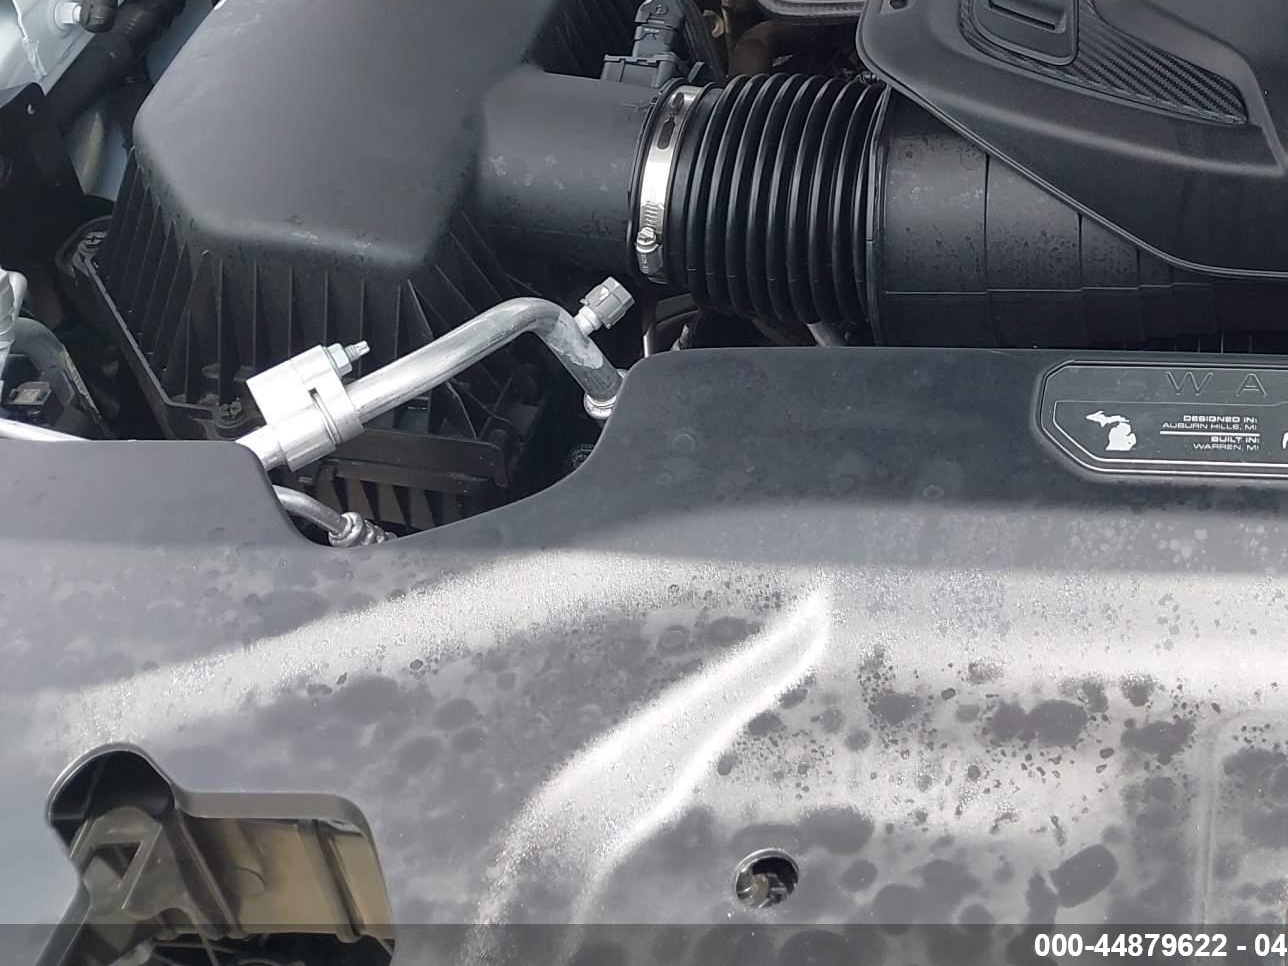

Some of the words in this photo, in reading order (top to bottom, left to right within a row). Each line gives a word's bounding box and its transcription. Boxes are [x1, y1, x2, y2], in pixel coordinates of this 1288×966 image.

[1183, 415, 1241, 424] DESIGNED
[1243, 416, 1258, 424] IN:
[1162, 422, 1207, 431] AUBURN
[1245, 423, 1258, 431] MI
[1211, 436, 1241, 444] BUILT
[1244, 436, 1259, 444] IN:
[1193, 443, 1242, 452] WARREN,
